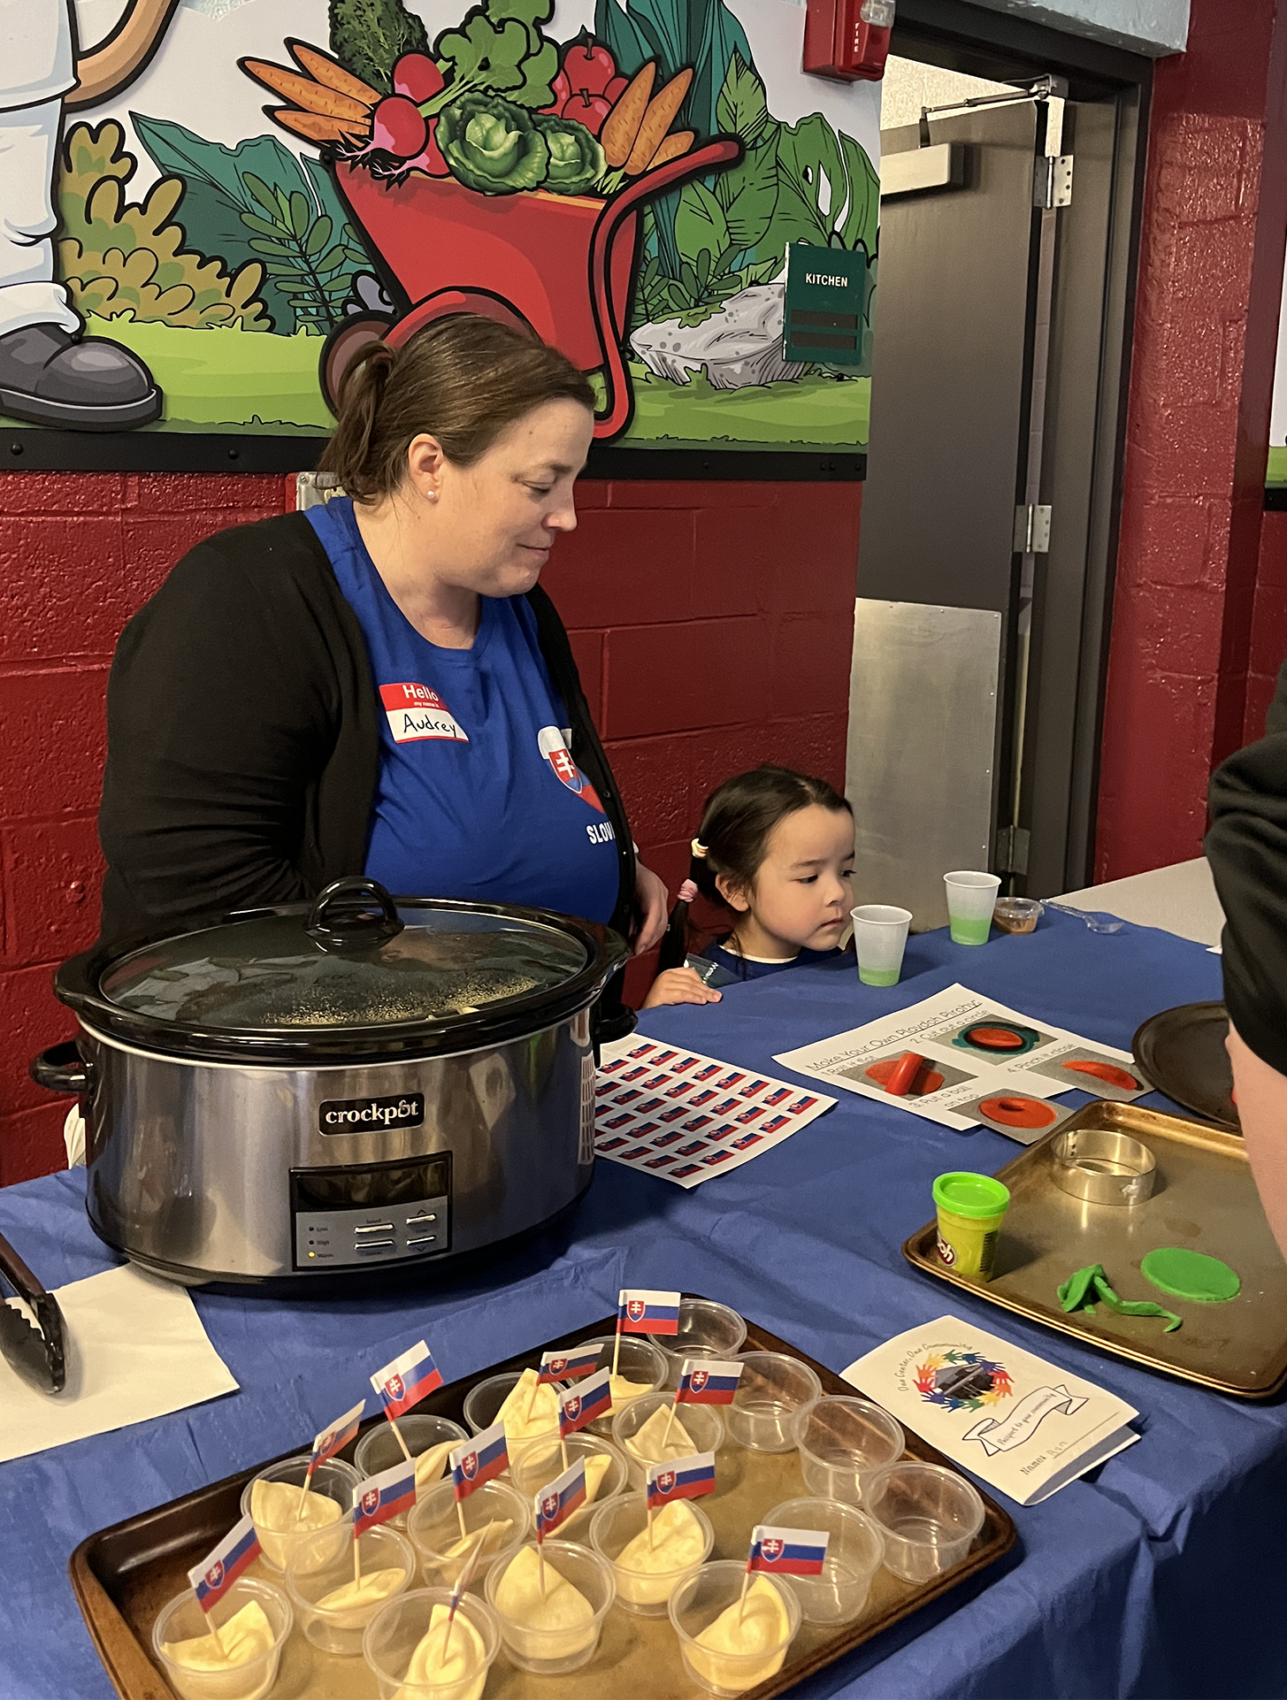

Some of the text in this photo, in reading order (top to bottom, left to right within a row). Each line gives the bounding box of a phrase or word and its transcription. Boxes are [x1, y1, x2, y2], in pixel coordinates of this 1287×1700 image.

[805, 272, 848, 288] KITCHEN
[402, 684, 439, 701] Hello
[403, 713, 457, 738] Audrey
[805, 1055, 842, 1071] Make
[839, 1045, 869, 1058] Your
[869, 1034, 899, 1047] Own
[895, 1015, 941, 1035] Playdoh
[325, 1099, 419, 1125] crockpot
[897, 1380, 909, 1392] One
[907, 1348, 923, 1358] One
[1019, 1455, 1047, 1475] Name:
